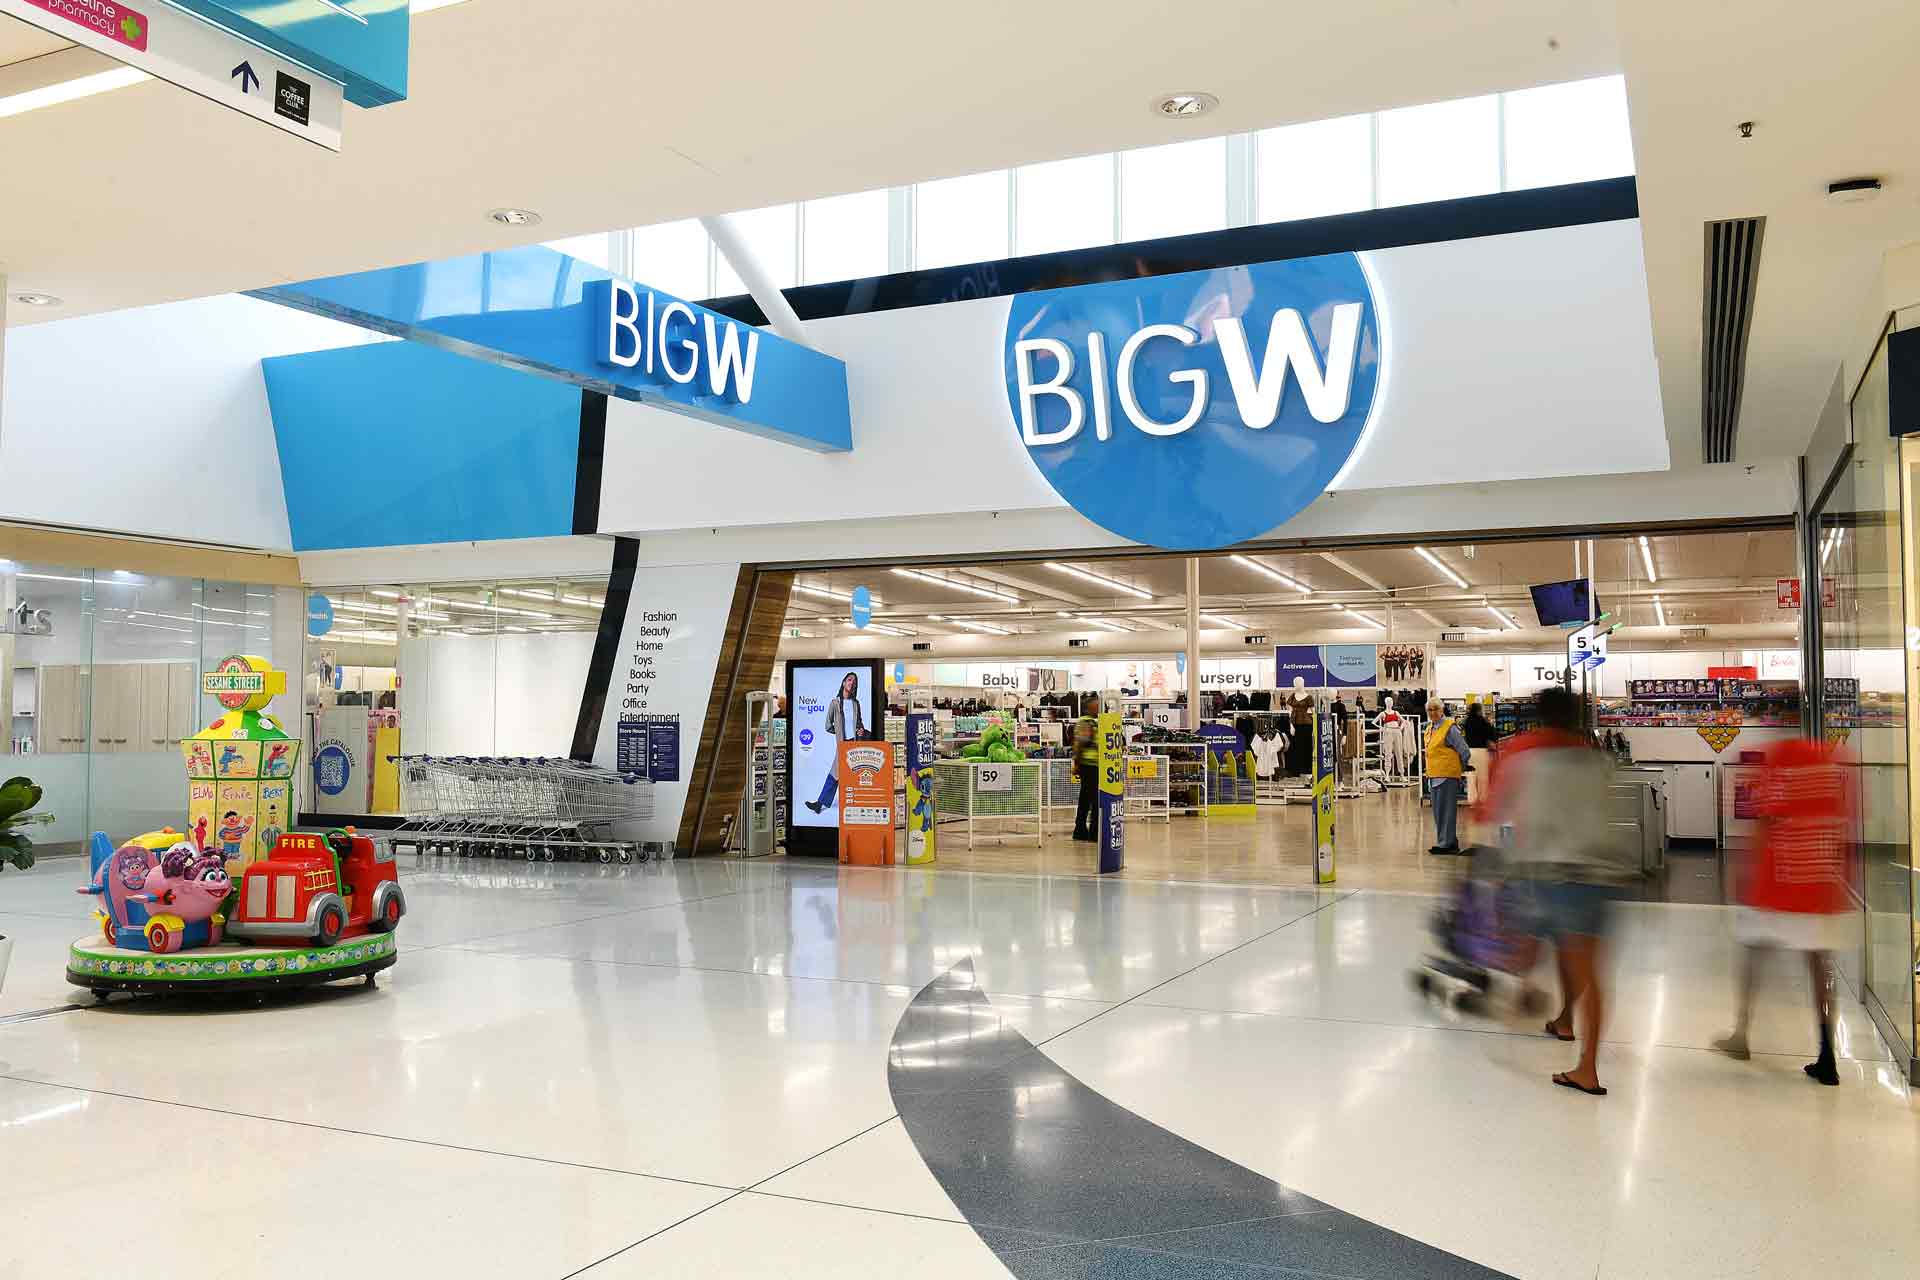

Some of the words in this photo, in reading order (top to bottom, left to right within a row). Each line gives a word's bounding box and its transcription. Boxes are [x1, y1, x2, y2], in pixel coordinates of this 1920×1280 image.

[76, 0, 116, 18] eline
[48, 0, 116, 36] pharmacy
[281, 89, 305, 105] COFFEE
[643, 611, 677, 622] Fashion
[640, 626, 670, 638] Beauty
[636, 640, 663, 651] Home
[1577, 637, 1587, 649] 5
[1593, 645, 1601, 655] 4
[633, 655, 652, 666] Toys
[630, 669, 656, 679] Books
[1200, 672, 1252, 687] ursery
[1534, 667, 1577, 684] Toys
[207, 676, 232, 689] SESAME
[233, 676, 258, 689] STREET
[982, 673, 1018, 688] Baby
[626, 683, 649, 696] Party
[622, 698, 647, 709] Office
[799, 695, 817, 704] New
[807, 705, 825, 715] you
[620, 711, 680, 722] Entertainment
[918, 721, 933, 734] BIG
[1111, 801, 1124, 816] BIG
[282, 838, 316, 849] FIRE
